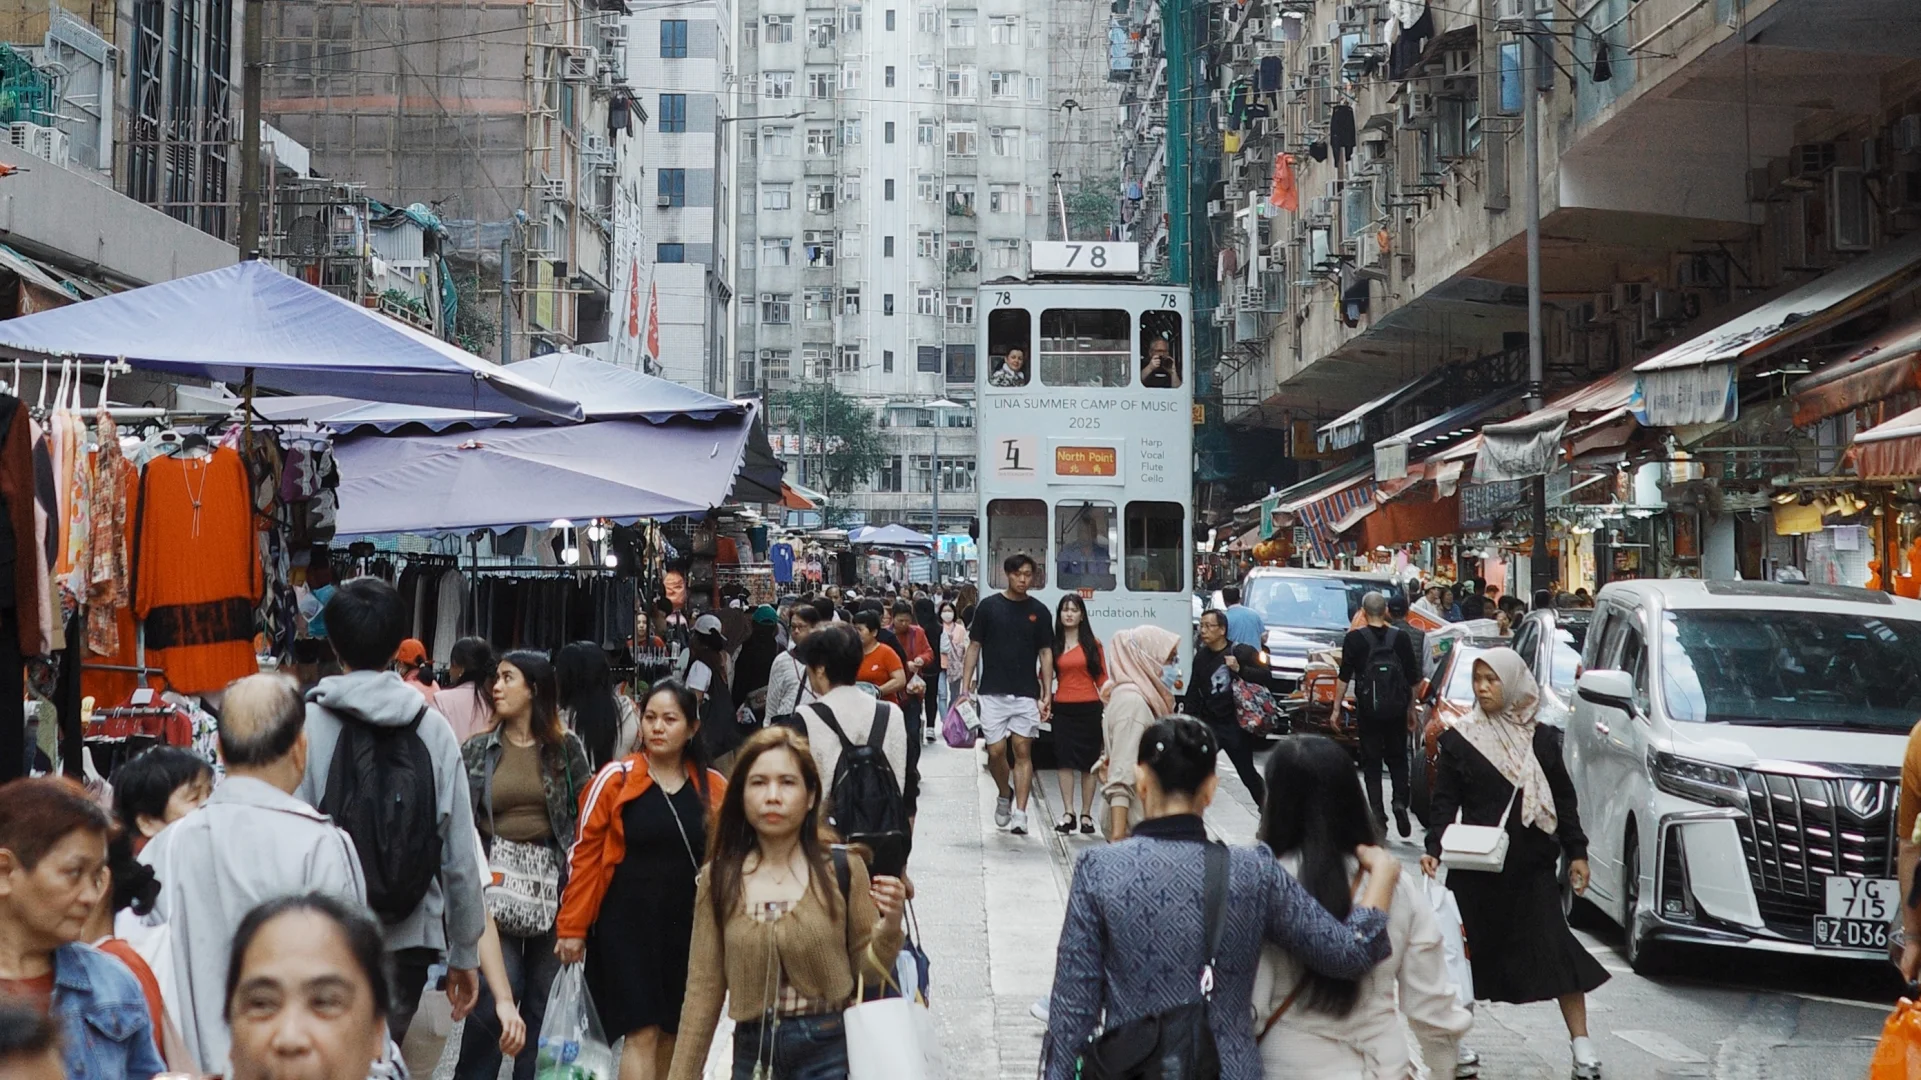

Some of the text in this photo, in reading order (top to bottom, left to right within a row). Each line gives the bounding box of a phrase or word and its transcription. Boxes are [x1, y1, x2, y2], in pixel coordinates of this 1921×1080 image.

[1065, 245, 1107, 268] 78
[995, 292, 1011, 306] 78
[1160, 294, 1177, 308] 78
[994, 399, 1178, 412] LINA SUMMER CAMP OF MUSIC
[1069, 417, 1101, 429] 2025
[1141, 437, 1163, 449] Harp
[1057, 451, 1114, 463] North Point
[1141, 450, 1165, 460] Vocal
[1141, 462, 1164, 472] Flute
[1141, 473, 1164, 483] Cello
[1088, 606, 1157, 619] undation.hk
[1849, 879, 1880, 899] YG
[1842, 898, 1885, 918] 715
